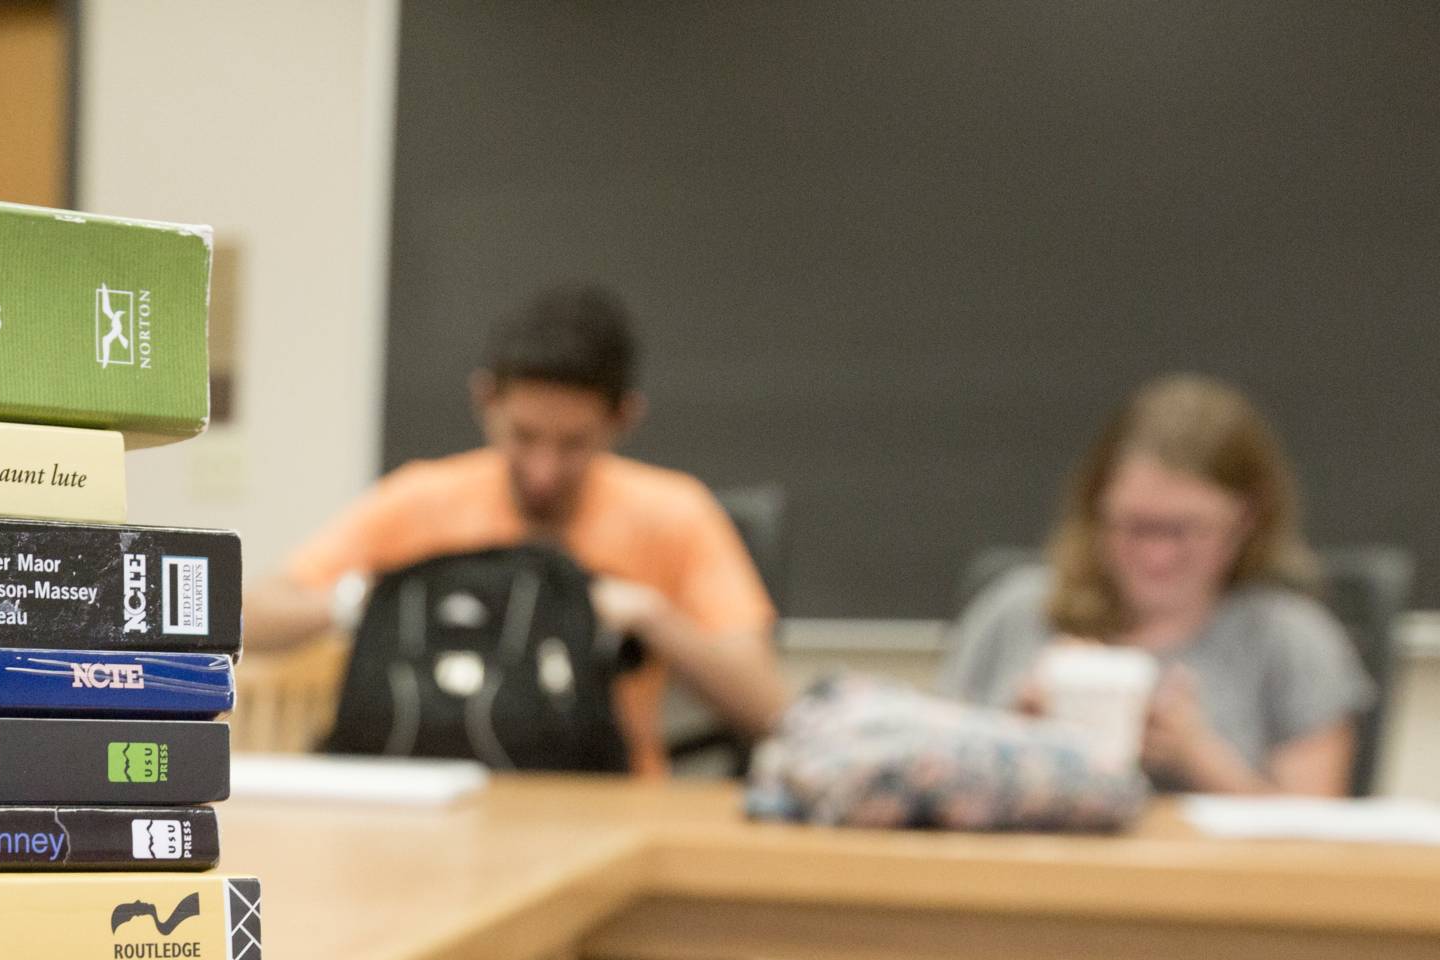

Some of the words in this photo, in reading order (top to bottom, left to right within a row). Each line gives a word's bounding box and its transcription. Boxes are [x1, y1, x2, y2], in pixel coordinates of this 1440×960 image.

[139, 289, 152, 369] NORTON
[50, 463, 88, 488] lute
[17, 554, 61, 572] Maor
[123, 554, 148, 633] NCTE
[182, 564, 191, 626] BEDFORD
[70, 663, 144, 689] NCTE
[144, 747, 153, 778] USU
[160, 744, 168, 782] PRESS
[167, 824, 176, 854] USU
[184, 821, 192, 858] PRESS
[114, 943, 201, 959] ROUTLEDGE
